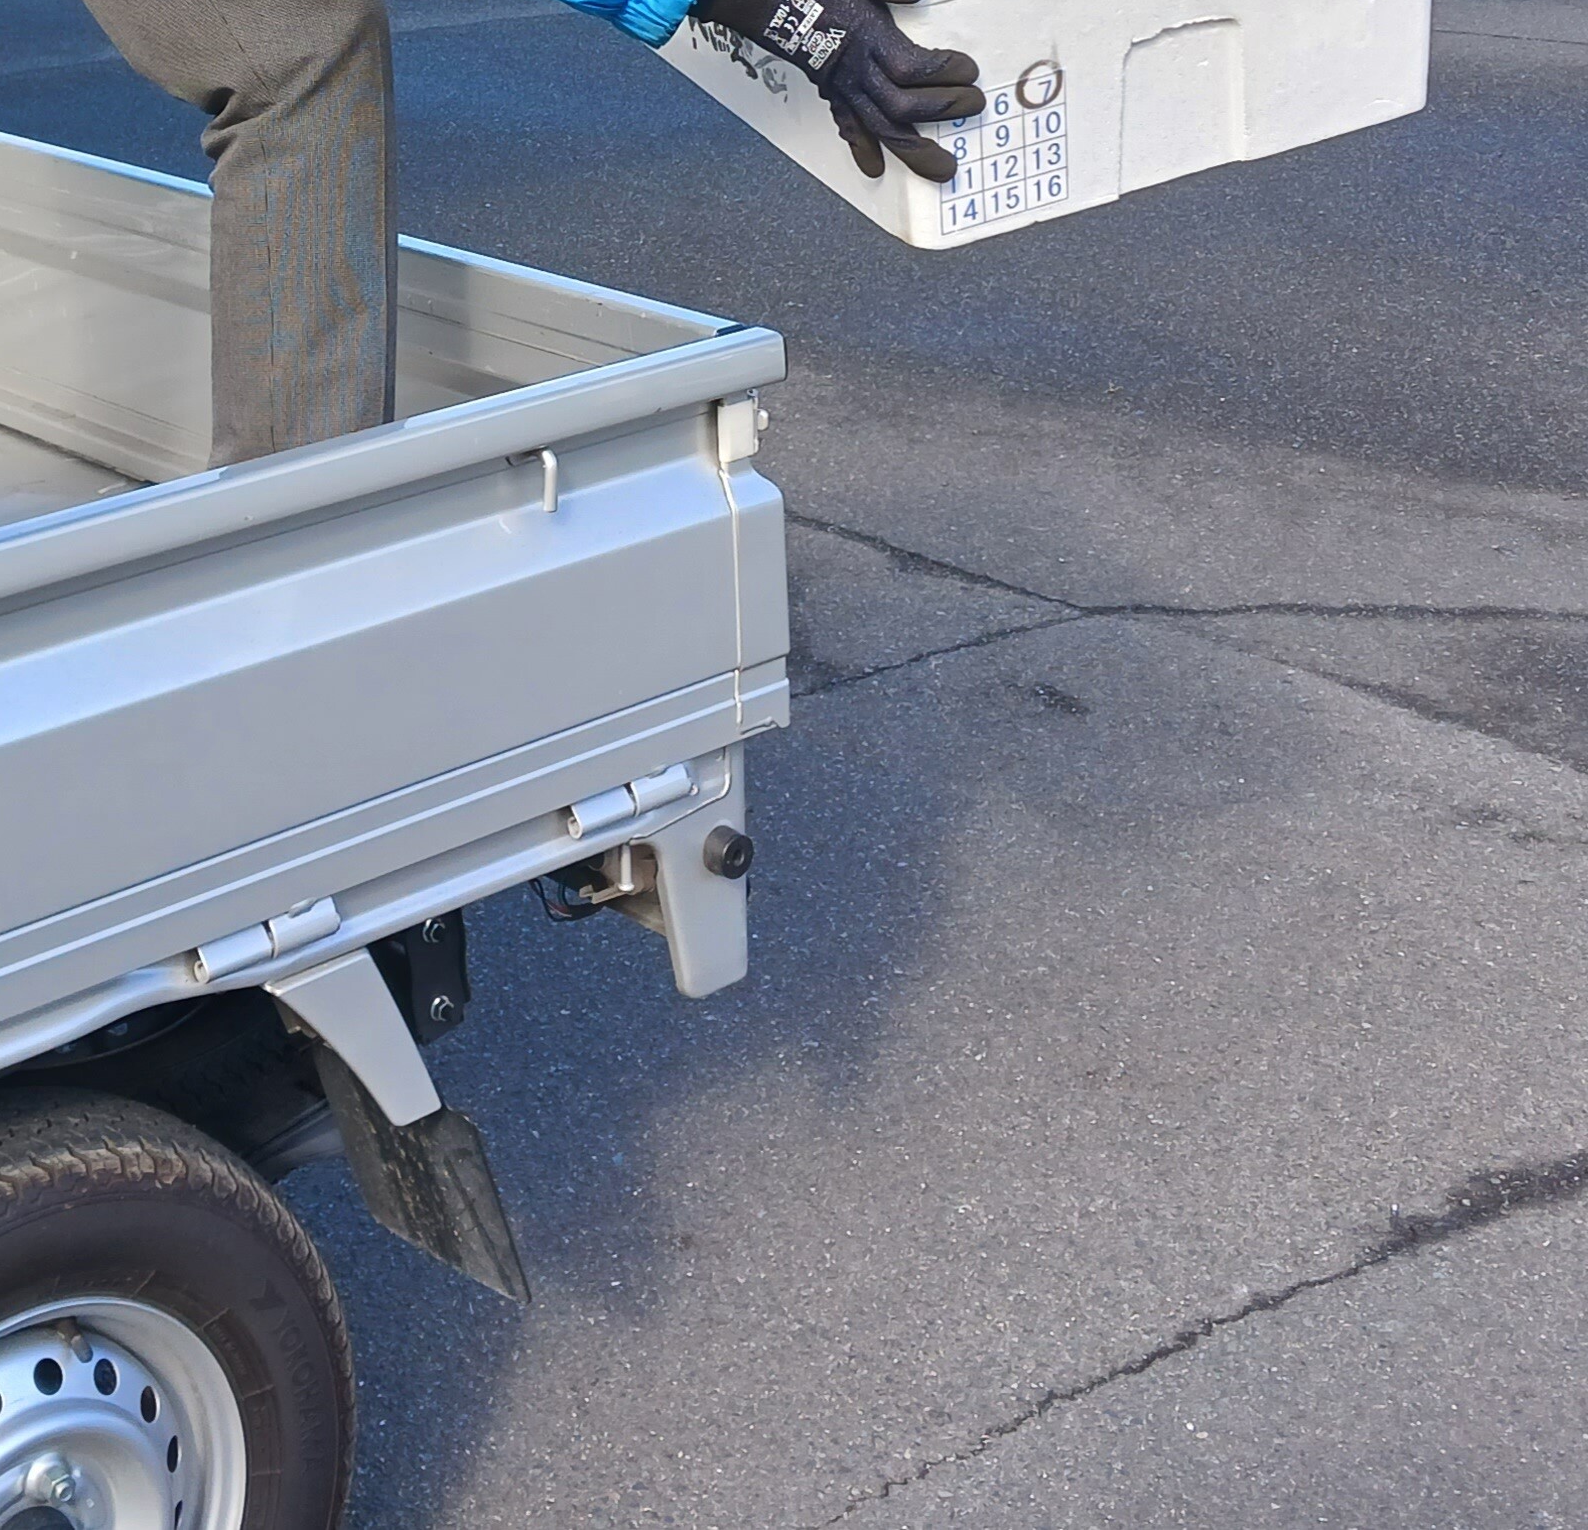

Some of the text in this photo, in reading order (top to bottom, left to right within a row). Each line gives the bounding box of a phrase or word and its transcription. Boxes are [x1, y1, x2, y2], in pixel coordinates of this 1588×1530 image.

[994, 79, 1053, 116] 6 7
[953, 110, 1062, 161] 8 9 10
[950, 142, 1062, 194] 11 12 13
[948, 174, 1062, 226] 14 15 16
